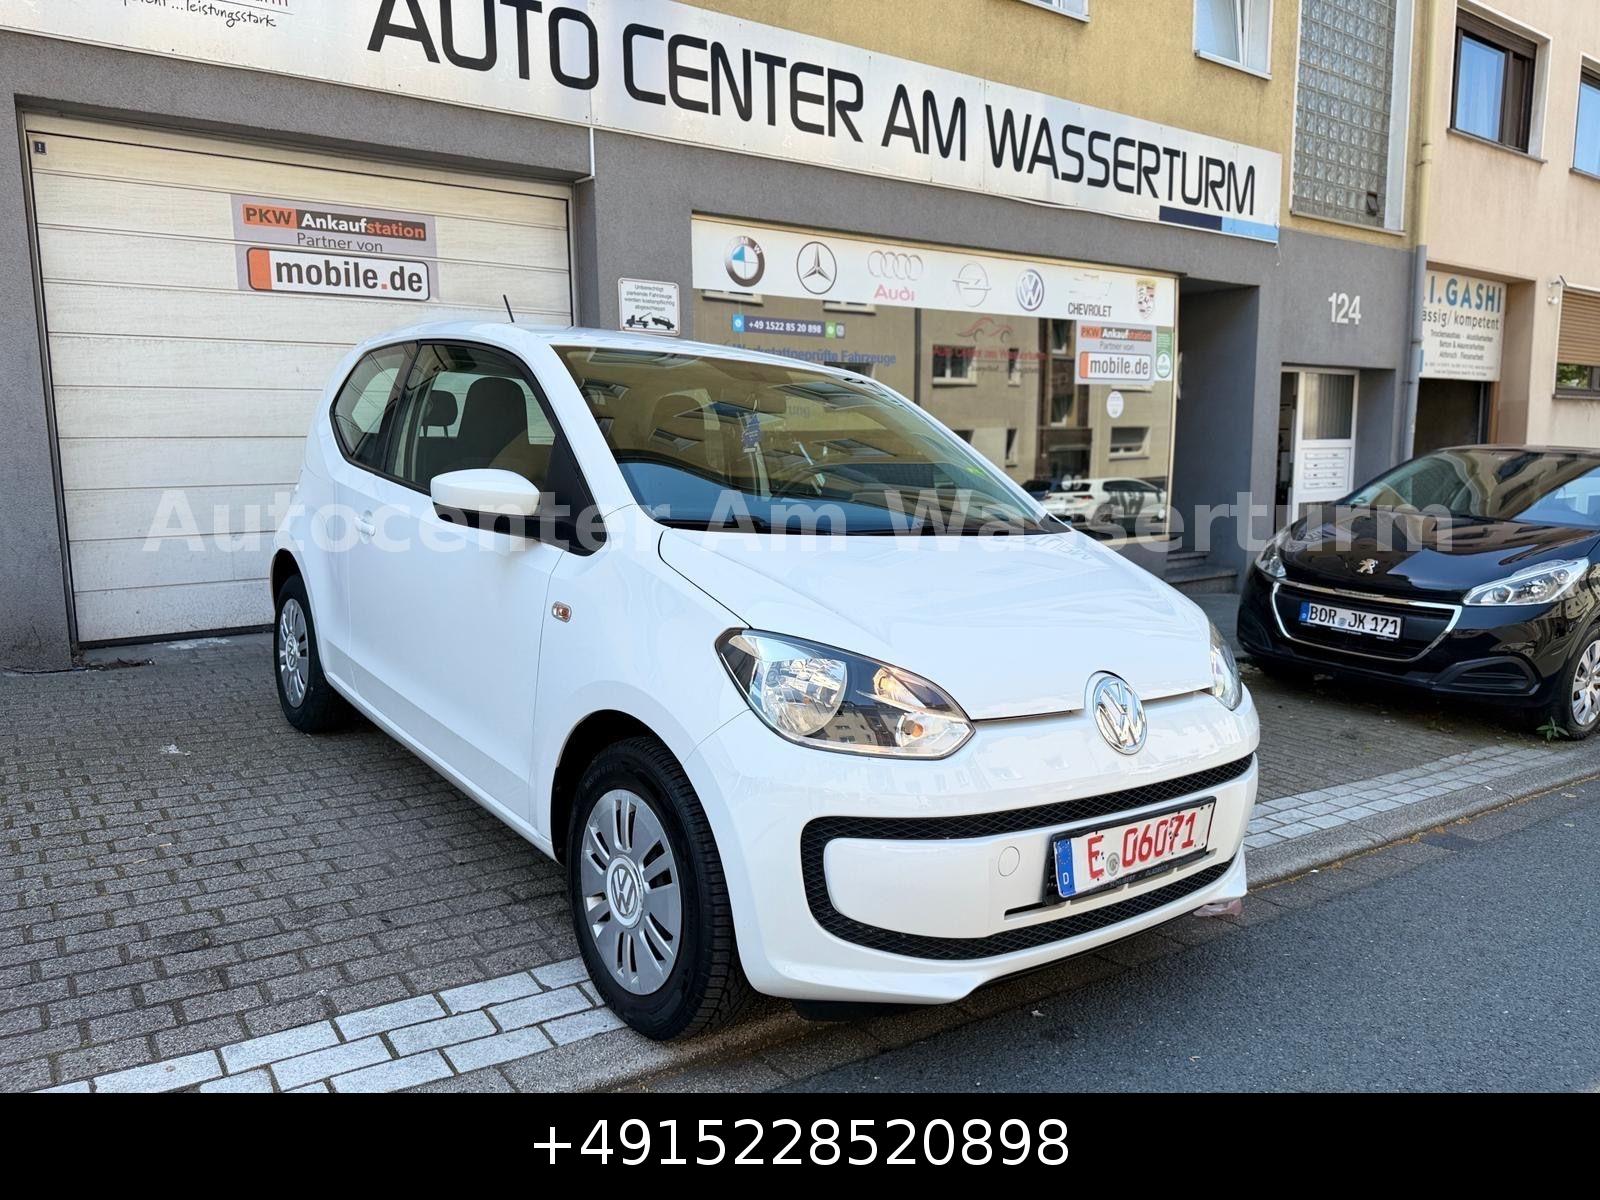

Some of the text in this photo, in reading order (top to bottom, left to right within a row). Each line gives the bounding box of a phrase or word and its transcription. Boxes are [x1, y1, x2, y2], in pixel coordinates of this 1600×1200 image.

[366, 0, 1256, 216] AUTO CENTER AM WASSERTURM
[245, 207, 425, 239] PKW Ankaufstation
[296, 232, 384, 252] Partner von
[275, 260, 423, 293] mobile.de
[873, 284, 915, 302] Audi
[1068, 302, 1113, 318] CHEVROLET
[1328, 292, 1362, 325] 124
[748, 320, 764, 330] +49
[765, 321, 784, 331] 1522
[785, 322, 795, 332] 85
[1454, 310, 1500, 330] kompetent
[1100, 341, 1135, 351] Partner von
[841, 350, 897, 367] Fahrzeuge
[1089, 356, 1149, 375] mobile.de
[1309, 605, 1337, 625] BOR
[1347, 612, 1367, 630] JK
[1370, 616, 1398, 636] 171
[1087, 834, 1105, 881] E
[1121, 811, 1197, 868] 06071
